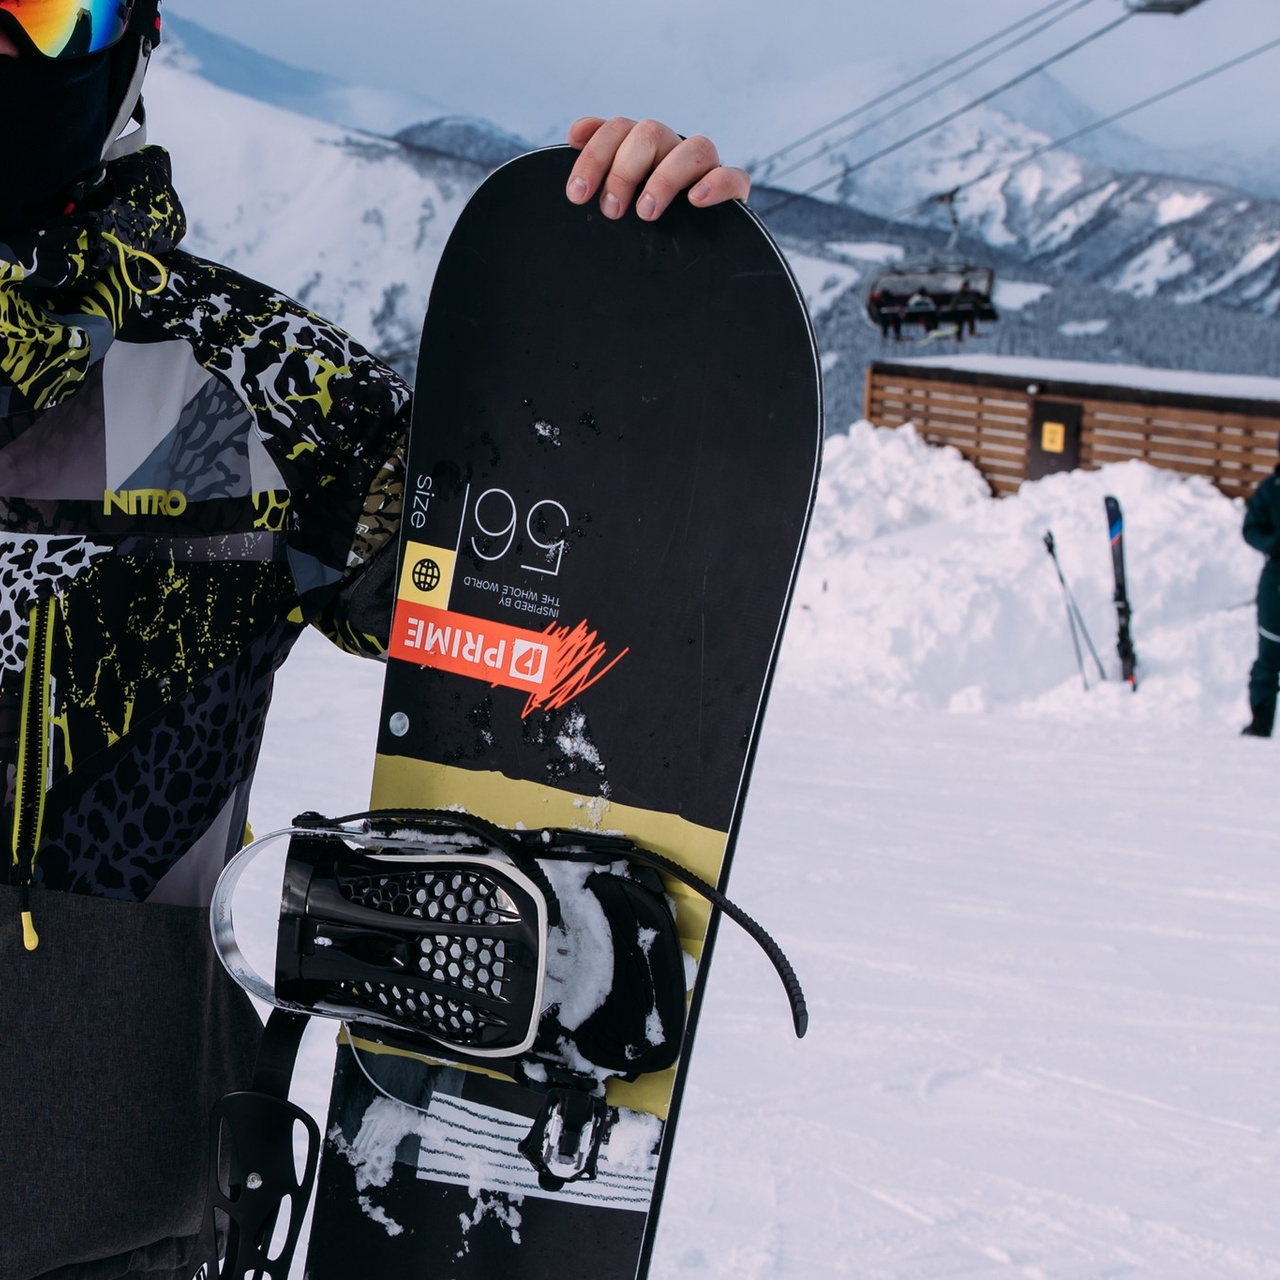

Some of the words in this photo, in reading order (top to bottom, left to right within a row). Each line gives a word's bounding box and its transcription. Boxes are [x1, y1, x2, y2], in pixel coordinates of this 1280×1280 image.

[103, 488, 187, 517] NITRO
[410, 475, 435, 529] size
[471, 488, 569, 576] 56
[463, 576, 499, 593] WORLD
[502, 585, 538, 602] WHOLE
[498, 596, 513, 607] BY
[514, 600, 560, 618] INSPIRED
[541, 594, 560, 607] THE
[404, 617, 506, 669] PRIME
